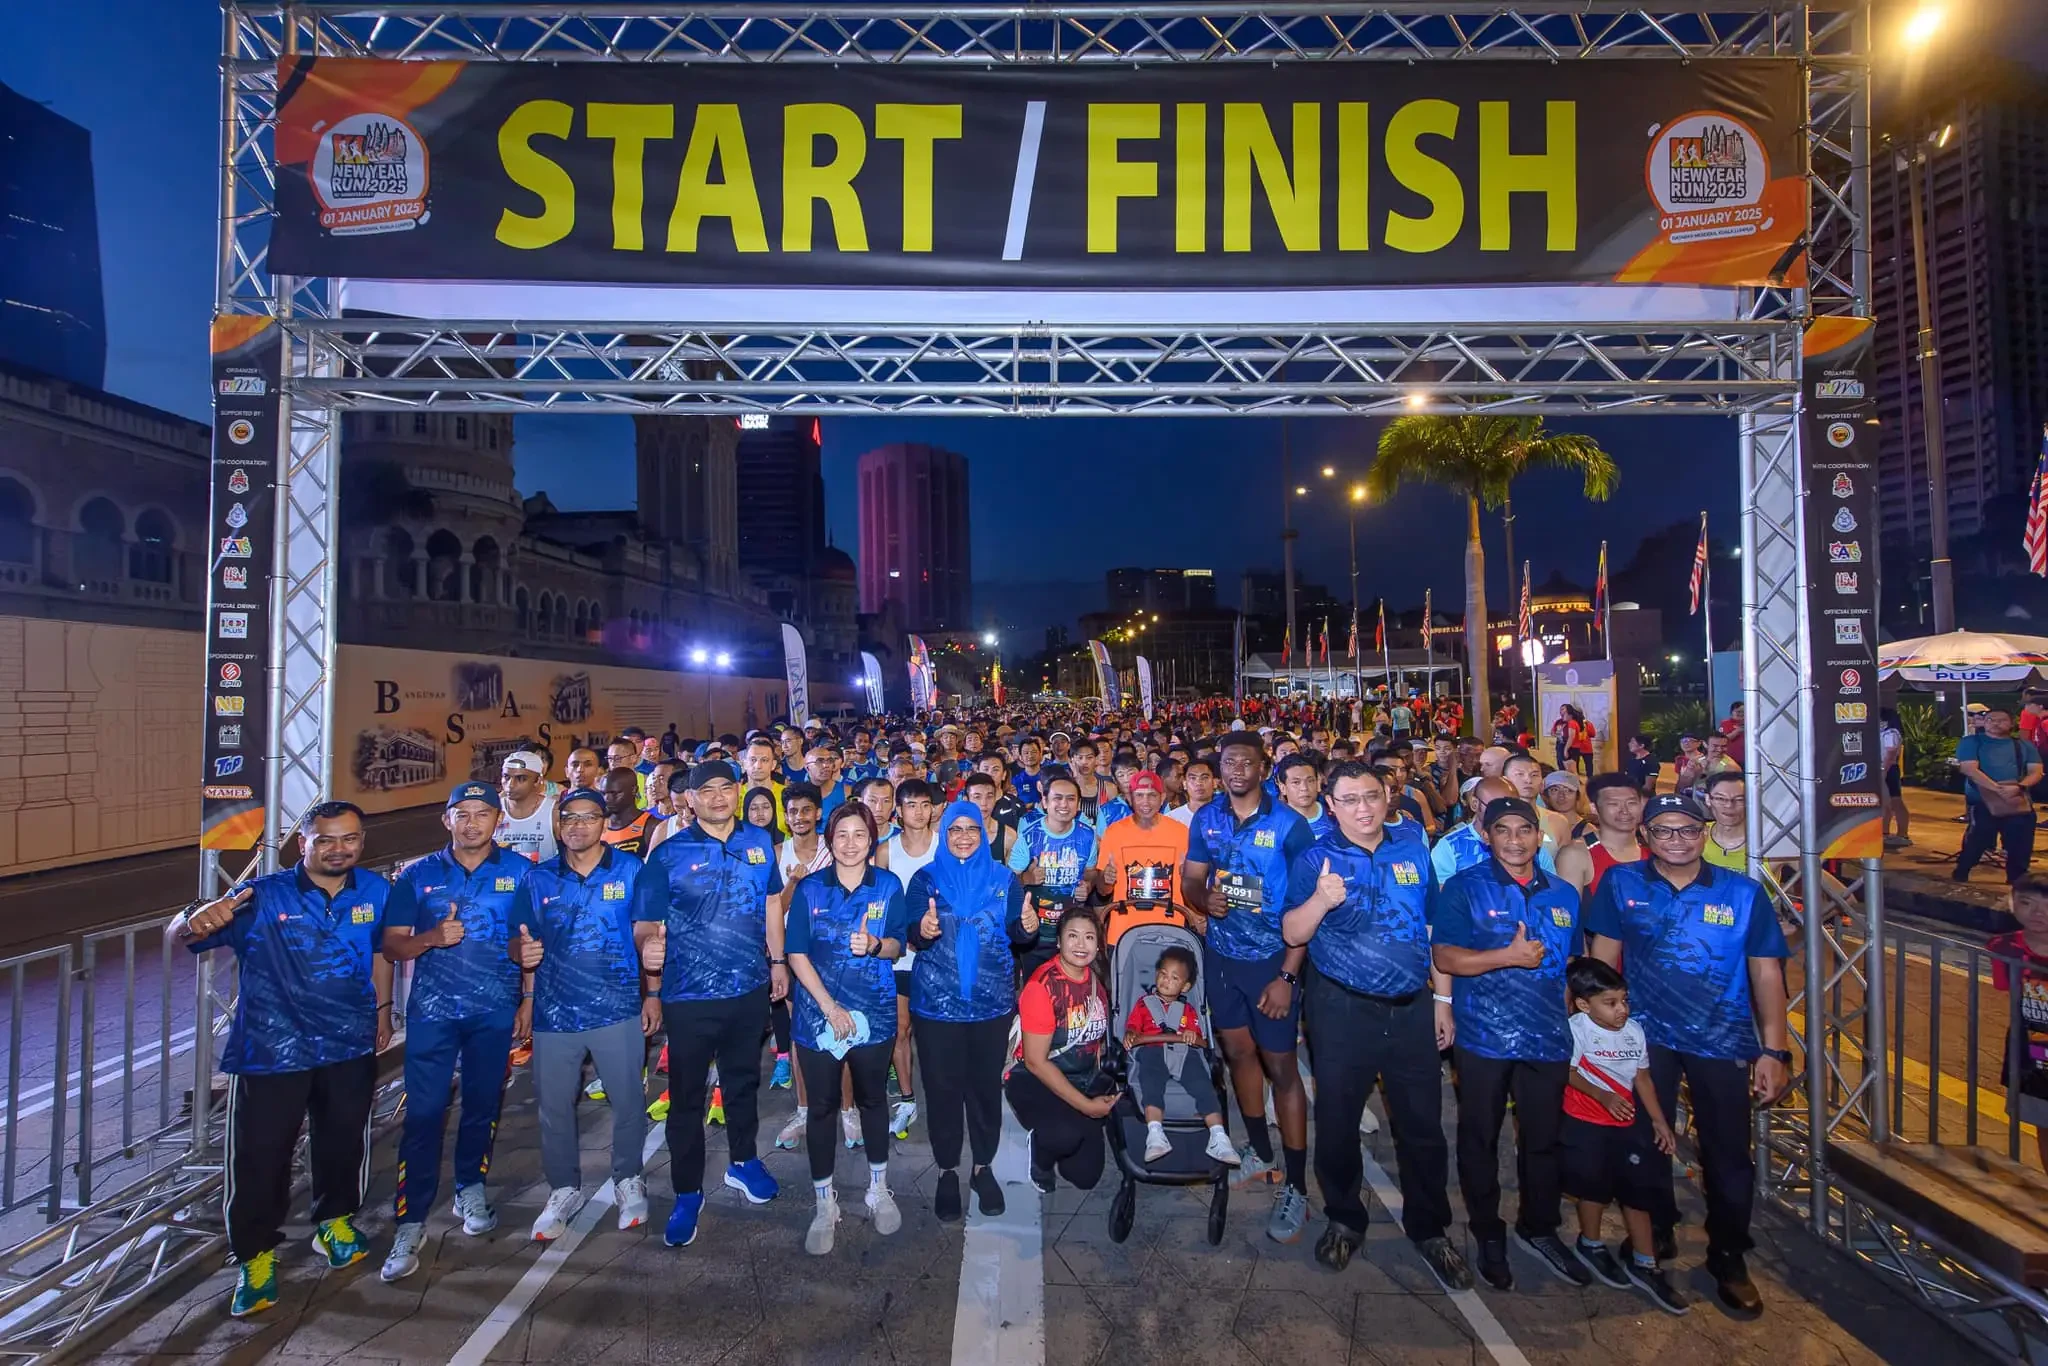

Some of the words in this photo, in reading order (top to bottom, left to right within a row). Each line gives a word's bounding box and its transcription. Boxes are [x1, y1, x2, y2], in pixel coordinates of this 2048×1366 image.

[333, 164, 366, 178] NEW
[369, 164, 406, 179] YEAR
[495, 100, 962, 252] START
[1087, 99, 1576, 252] FINISH
[1671, 168, 1704, 182] NEW
[1706, 168, 1744, 182] YEAR
[332, 178, 365, 192] RUN
[368, 180, 406, 193] 2025
[1671, 183, 1703, 197] RUN
[1708, 183, 1746, 197] 2025
[323, 213, 336, 225] 01
[338, 206, 392, 223] JANUARY
[394, 202, 420, 216] 2025
[1661, 218, 1673, 230] 01
[1675, 211, 1732, 228] JANUARY
[1734, 208, 1762, 221] 2025
[1936, 672, 1990, 680] PLUS
[207, 789, 248, 797] MAMEE
[502, 833, 545, 842] RWARD
[1222, 885, 1252, 899] F2091
